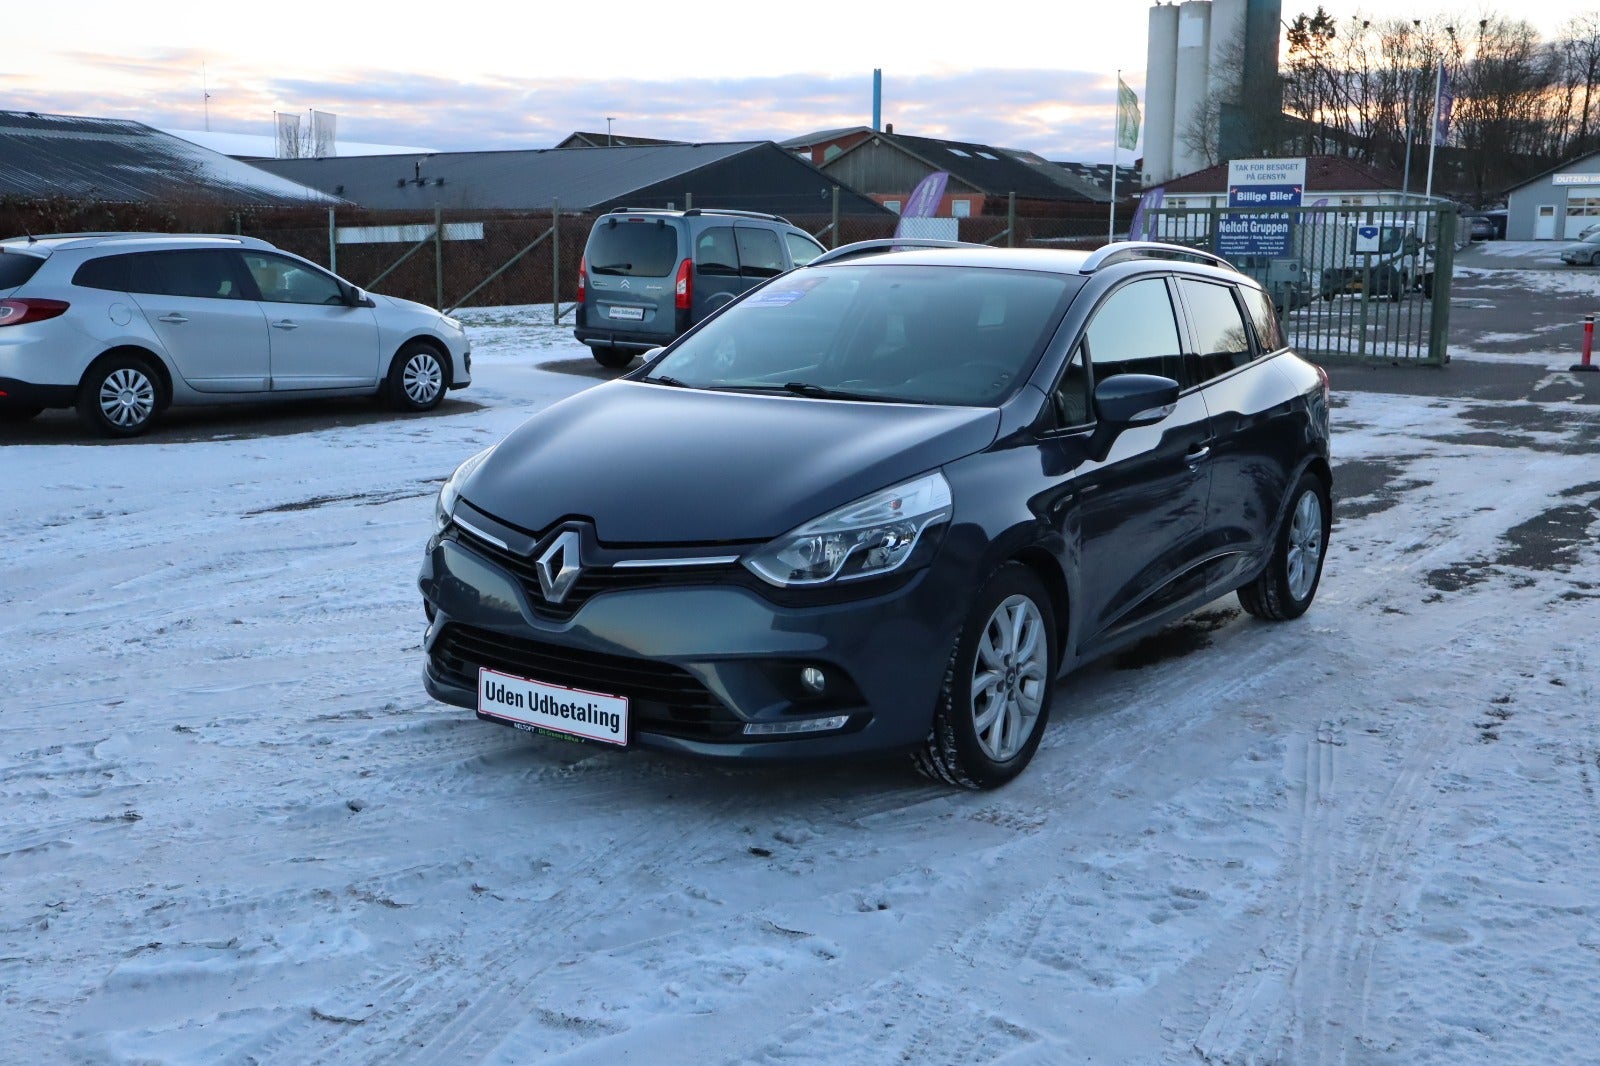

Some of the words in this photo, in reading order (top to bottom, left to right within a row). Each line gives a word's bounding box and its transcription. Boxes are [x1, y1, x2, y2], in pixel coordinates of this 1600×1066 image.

[1235, 164, 1249, 172] TAK
[1266, 163, 1299, 171] BESØGET
[1237, 192, 1267, 202] Billige
[1269, 191, 1294, 200] Biler
[1219, 221, 1249, 233] Neltoft
[1250, 221, 1288, 235] Gruppen
[485, 680, 524, 709] Uden
[528, 690, 620, 734] Udbetaling
[513, 722, 535, 733] NELTOFT
